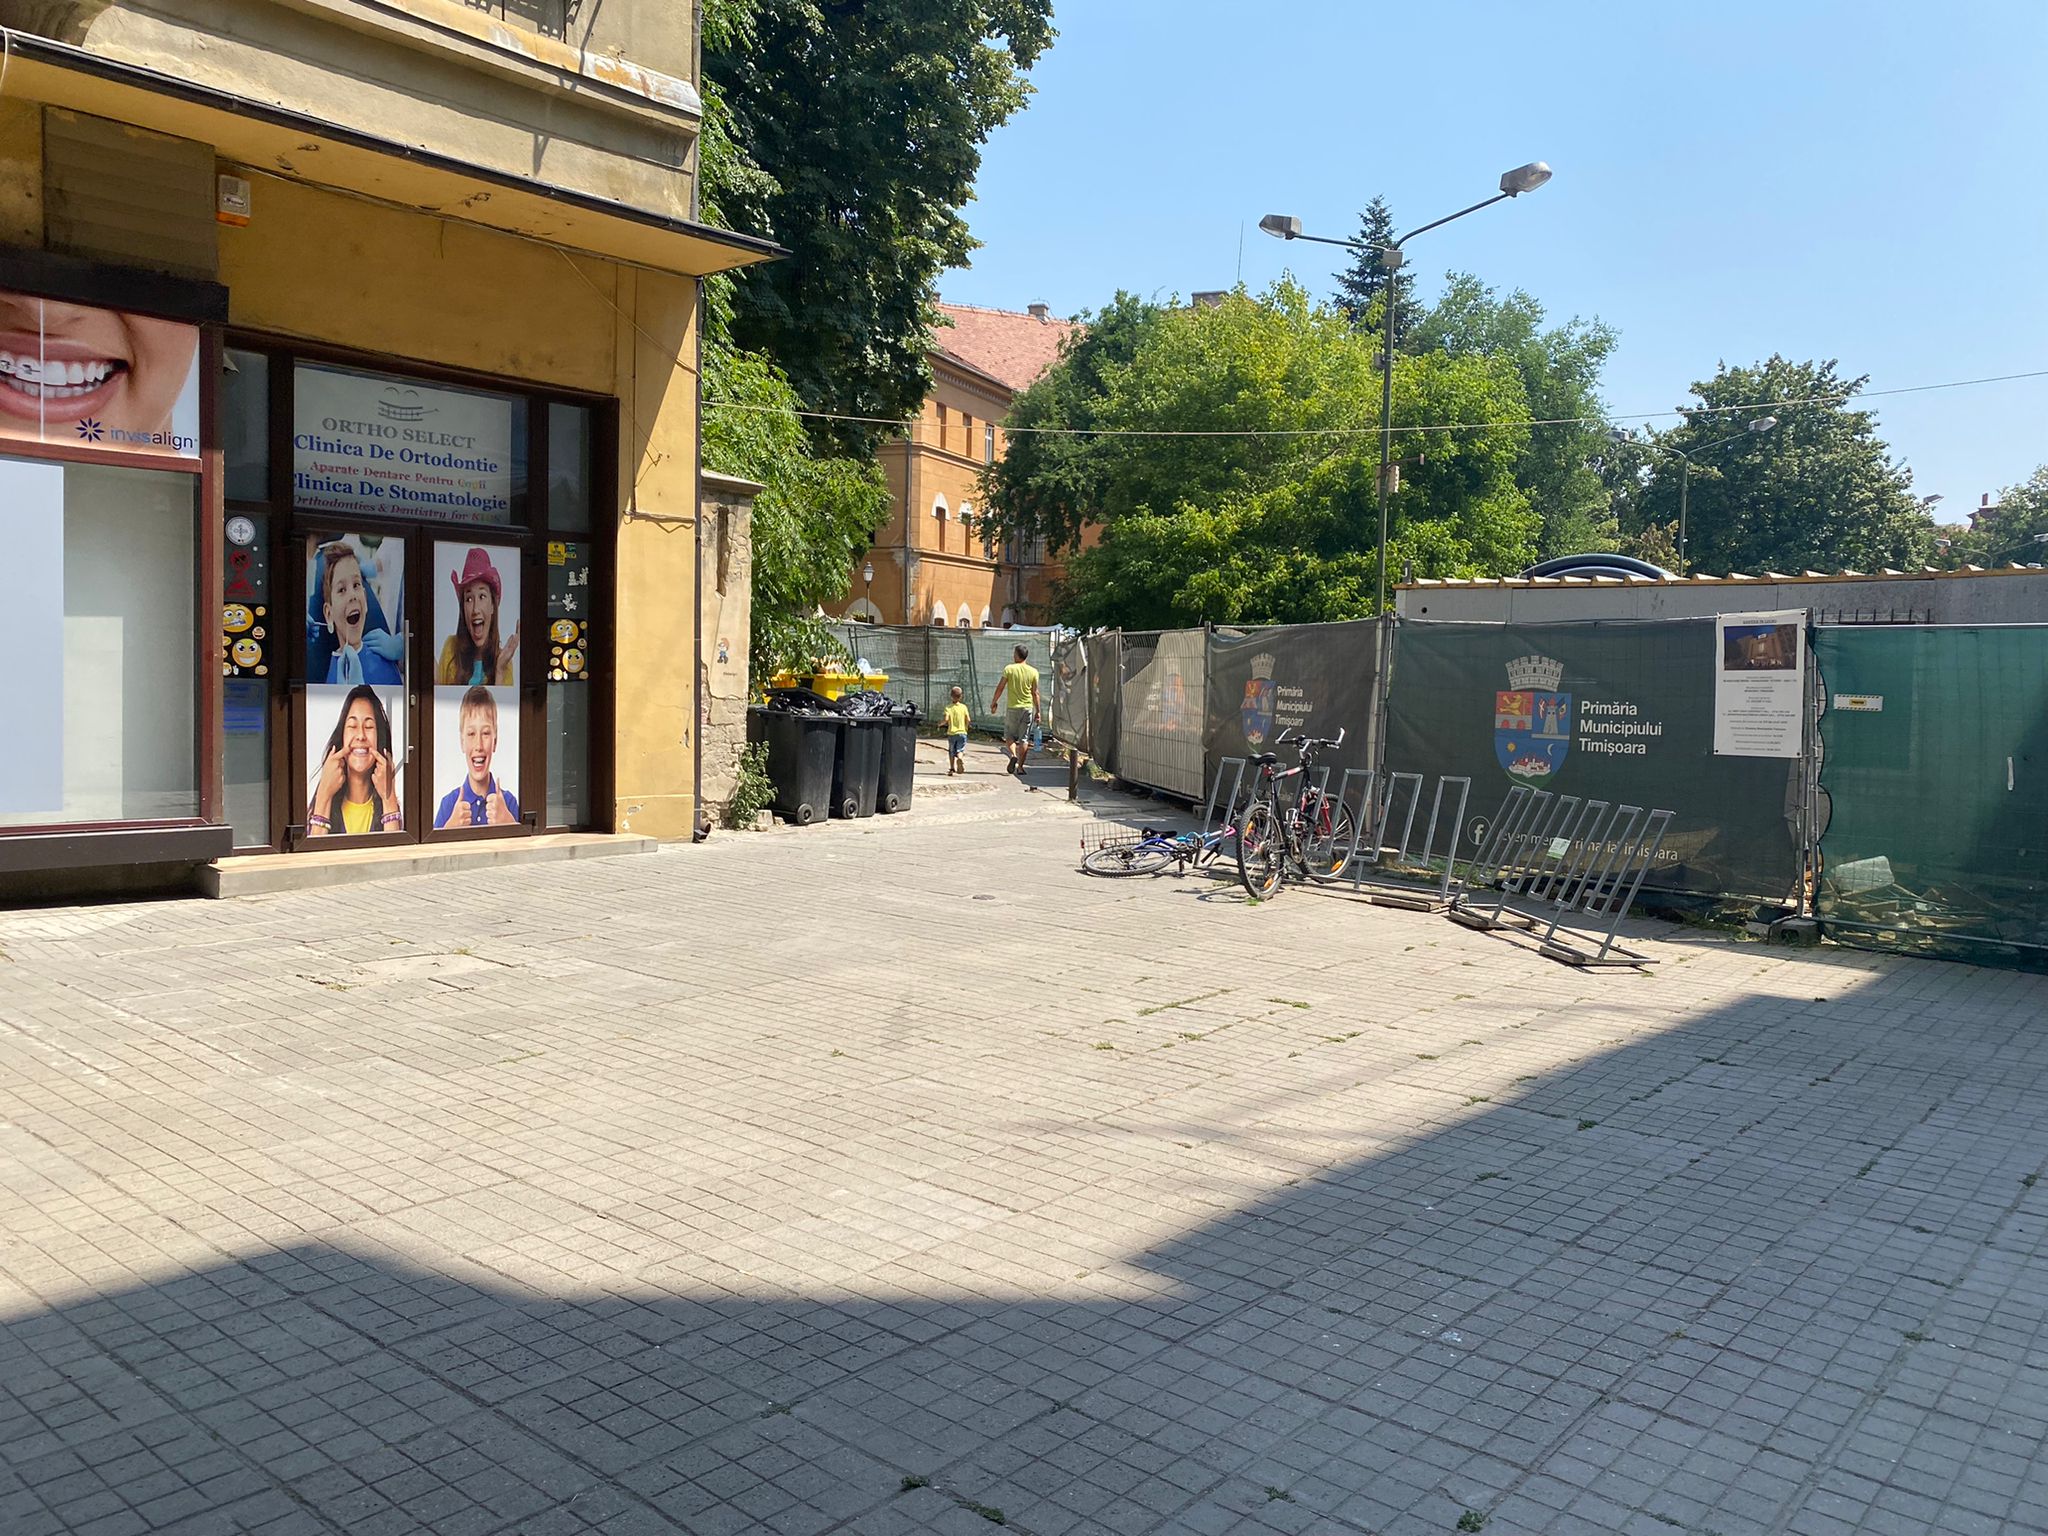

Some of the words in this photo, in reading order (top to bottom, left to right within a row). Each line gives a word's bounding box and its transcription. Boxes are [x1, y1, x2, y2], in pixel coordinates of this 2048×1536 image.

[110, 426, 194, 450] invisalign
[322, 417, 398, 439] ORTHO
[403, 428, 476, 449] SELECT
[294, 434, 363, 457] Clinica
[370, 444, 395, 460] De
[400, 448, 498, 473] Ortodontie
[310, 461, 360, 475] Aparate
[363, 467, 411, 481] Dentare
[415, 472, 454, 486] Pentru
[359, 481, 385, 497] De
[388, 484, 508, 511] Stomatologie
[448, 510, 469, 519] for
[1276, 700, 1313, 714] Municipiului
[1581, 700, 1638, 716] Primăria
[1579, 719, 1662, 737] Municipiului
[1579, 738, 1647, 756] Timișoara
